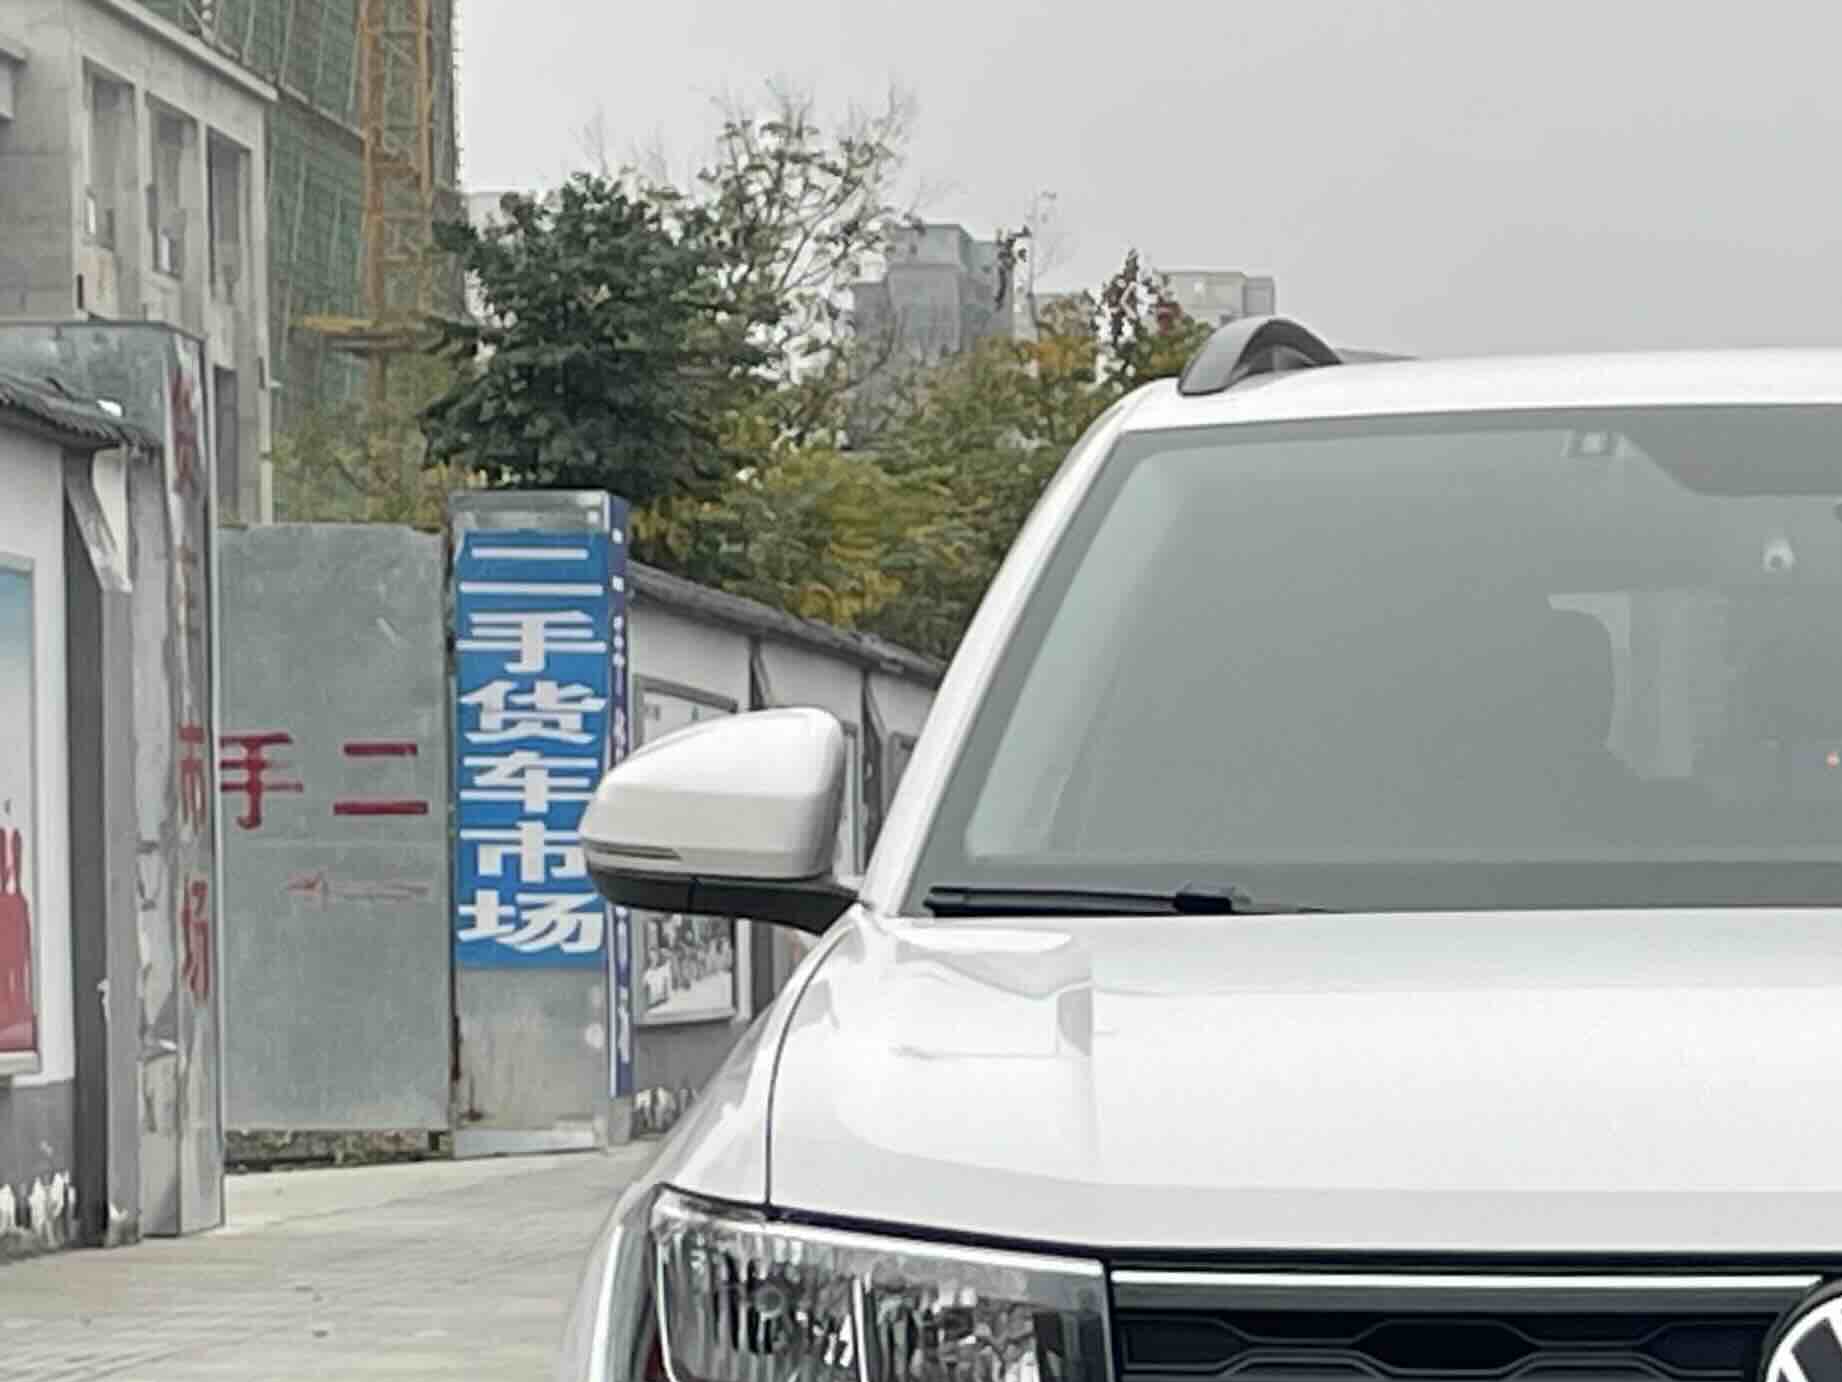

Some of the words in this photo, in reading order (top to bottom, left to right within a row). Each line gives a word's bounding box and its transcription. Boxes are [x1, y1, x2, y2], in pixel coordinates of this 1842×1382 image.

[456, 547, 606, 954] 二手货车市场
